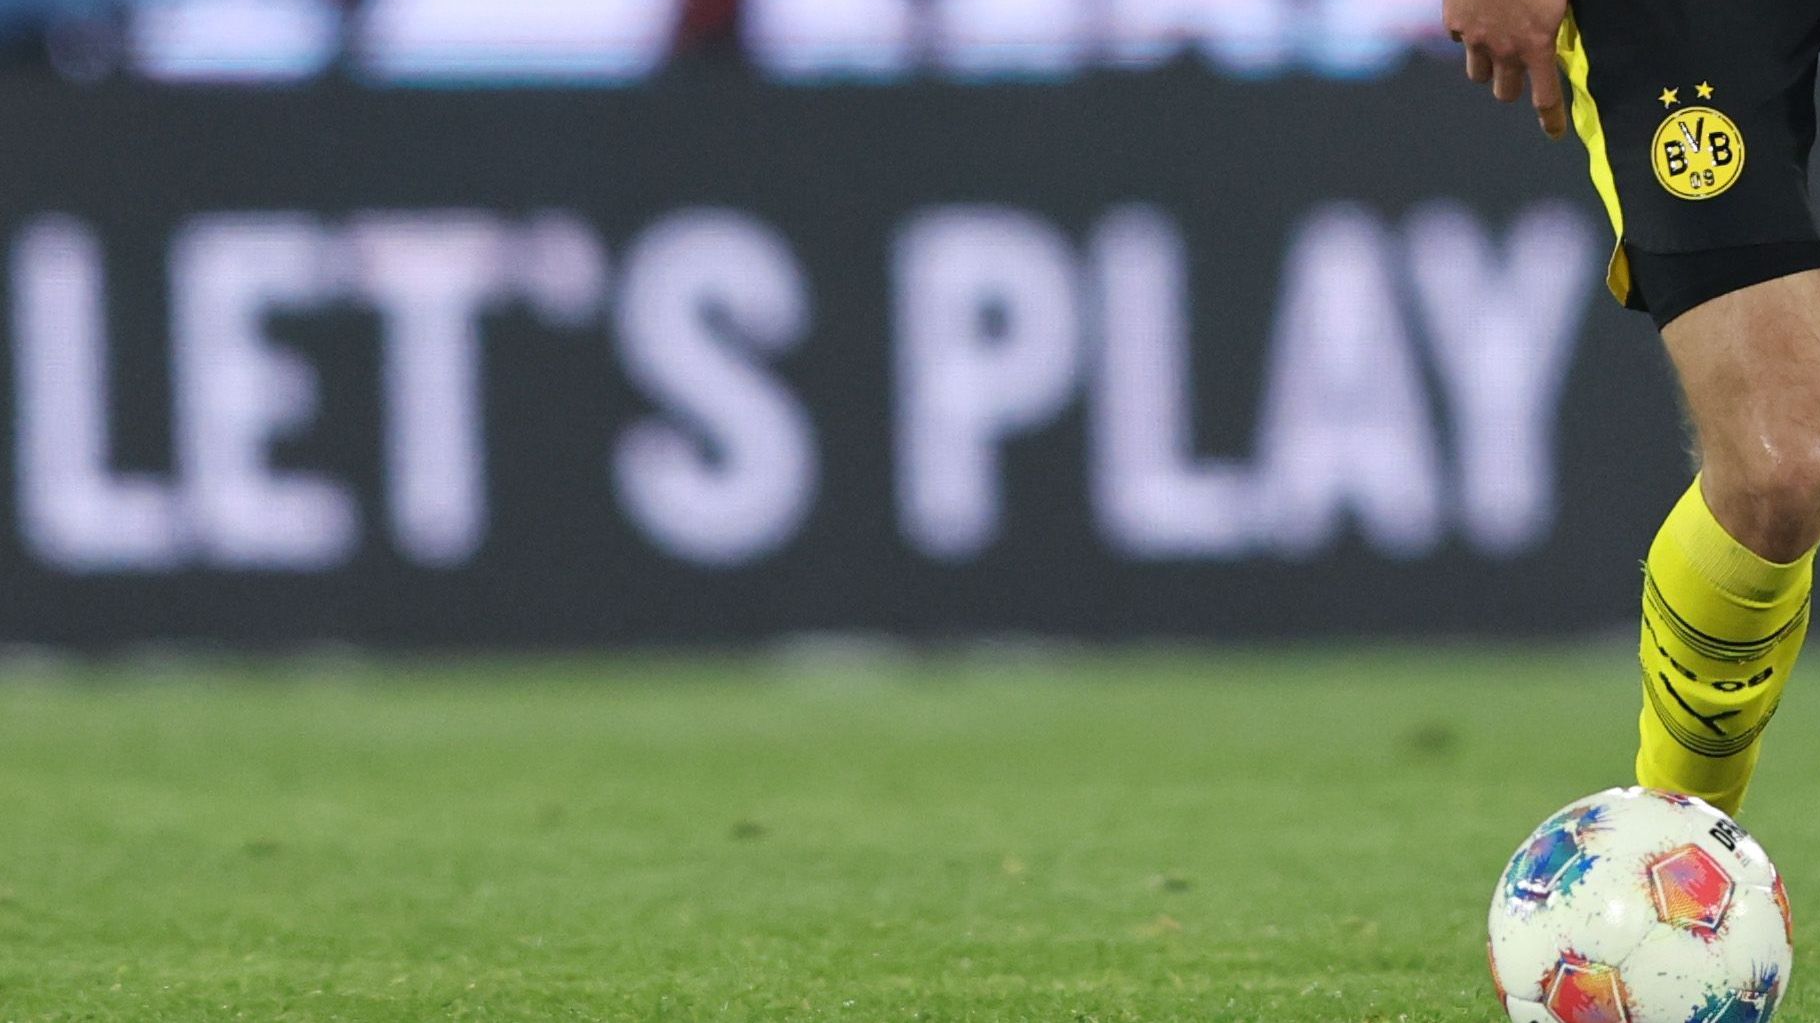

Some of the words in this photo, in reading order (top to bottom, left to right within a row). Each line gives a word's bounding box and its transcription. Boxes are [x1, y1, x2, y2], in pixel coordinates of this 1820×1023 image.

[1664, 117, 1732, 177] BVB
[1689, 169, 1715, 189] 09
[14, 204, 819, 568] LET'S
[890, 200, 1600, 562] PLAY
